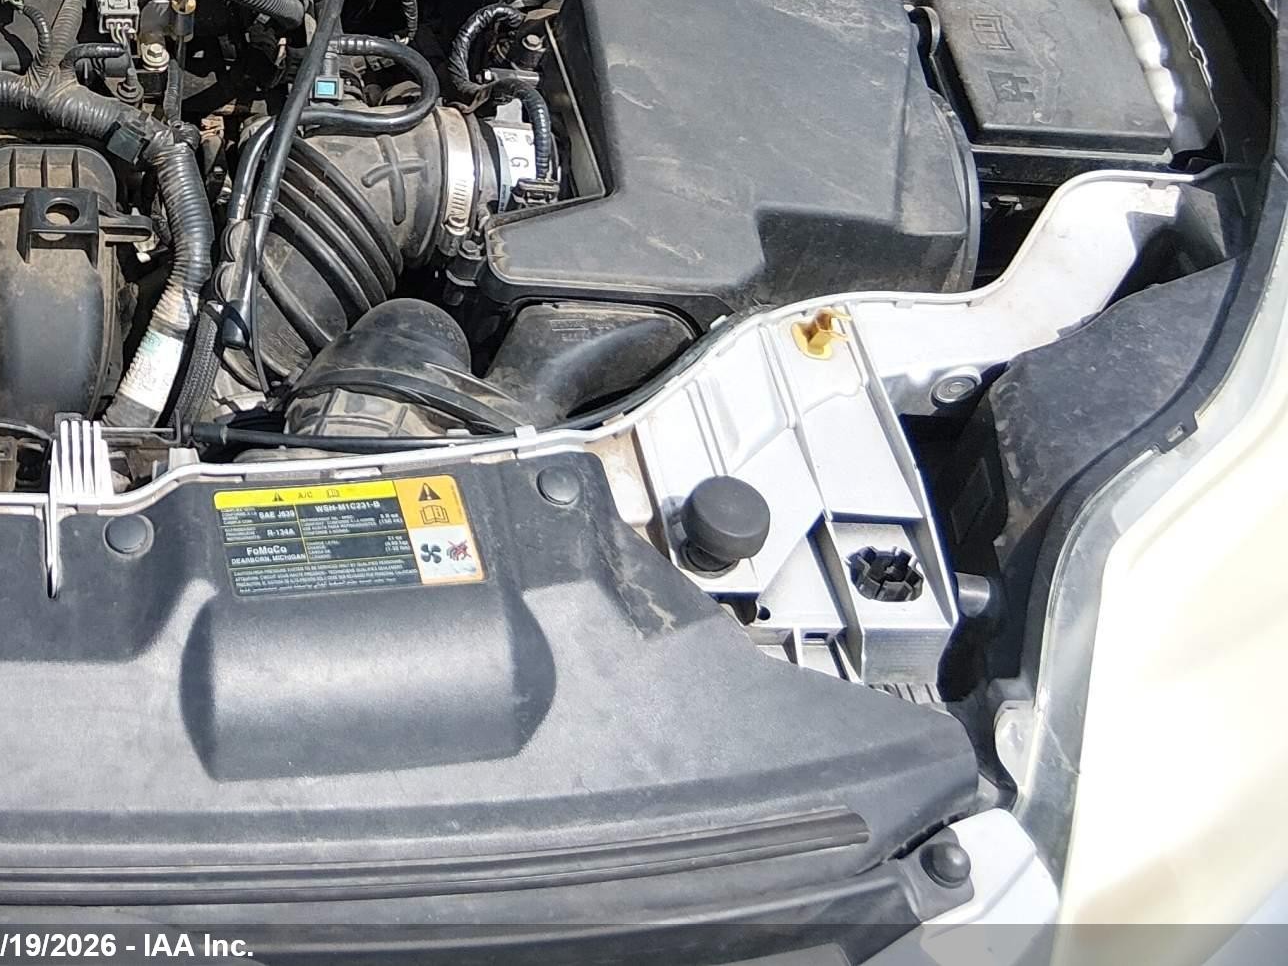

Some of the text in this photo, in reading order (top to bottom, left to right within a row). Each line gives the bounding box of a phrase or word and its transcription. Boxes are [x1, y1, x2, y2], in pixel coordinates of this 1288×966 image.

[297, 491, 313, 500] A/C
[258, 511, 277, 520] SAE
[266, 527, 296, 538] R-134A
